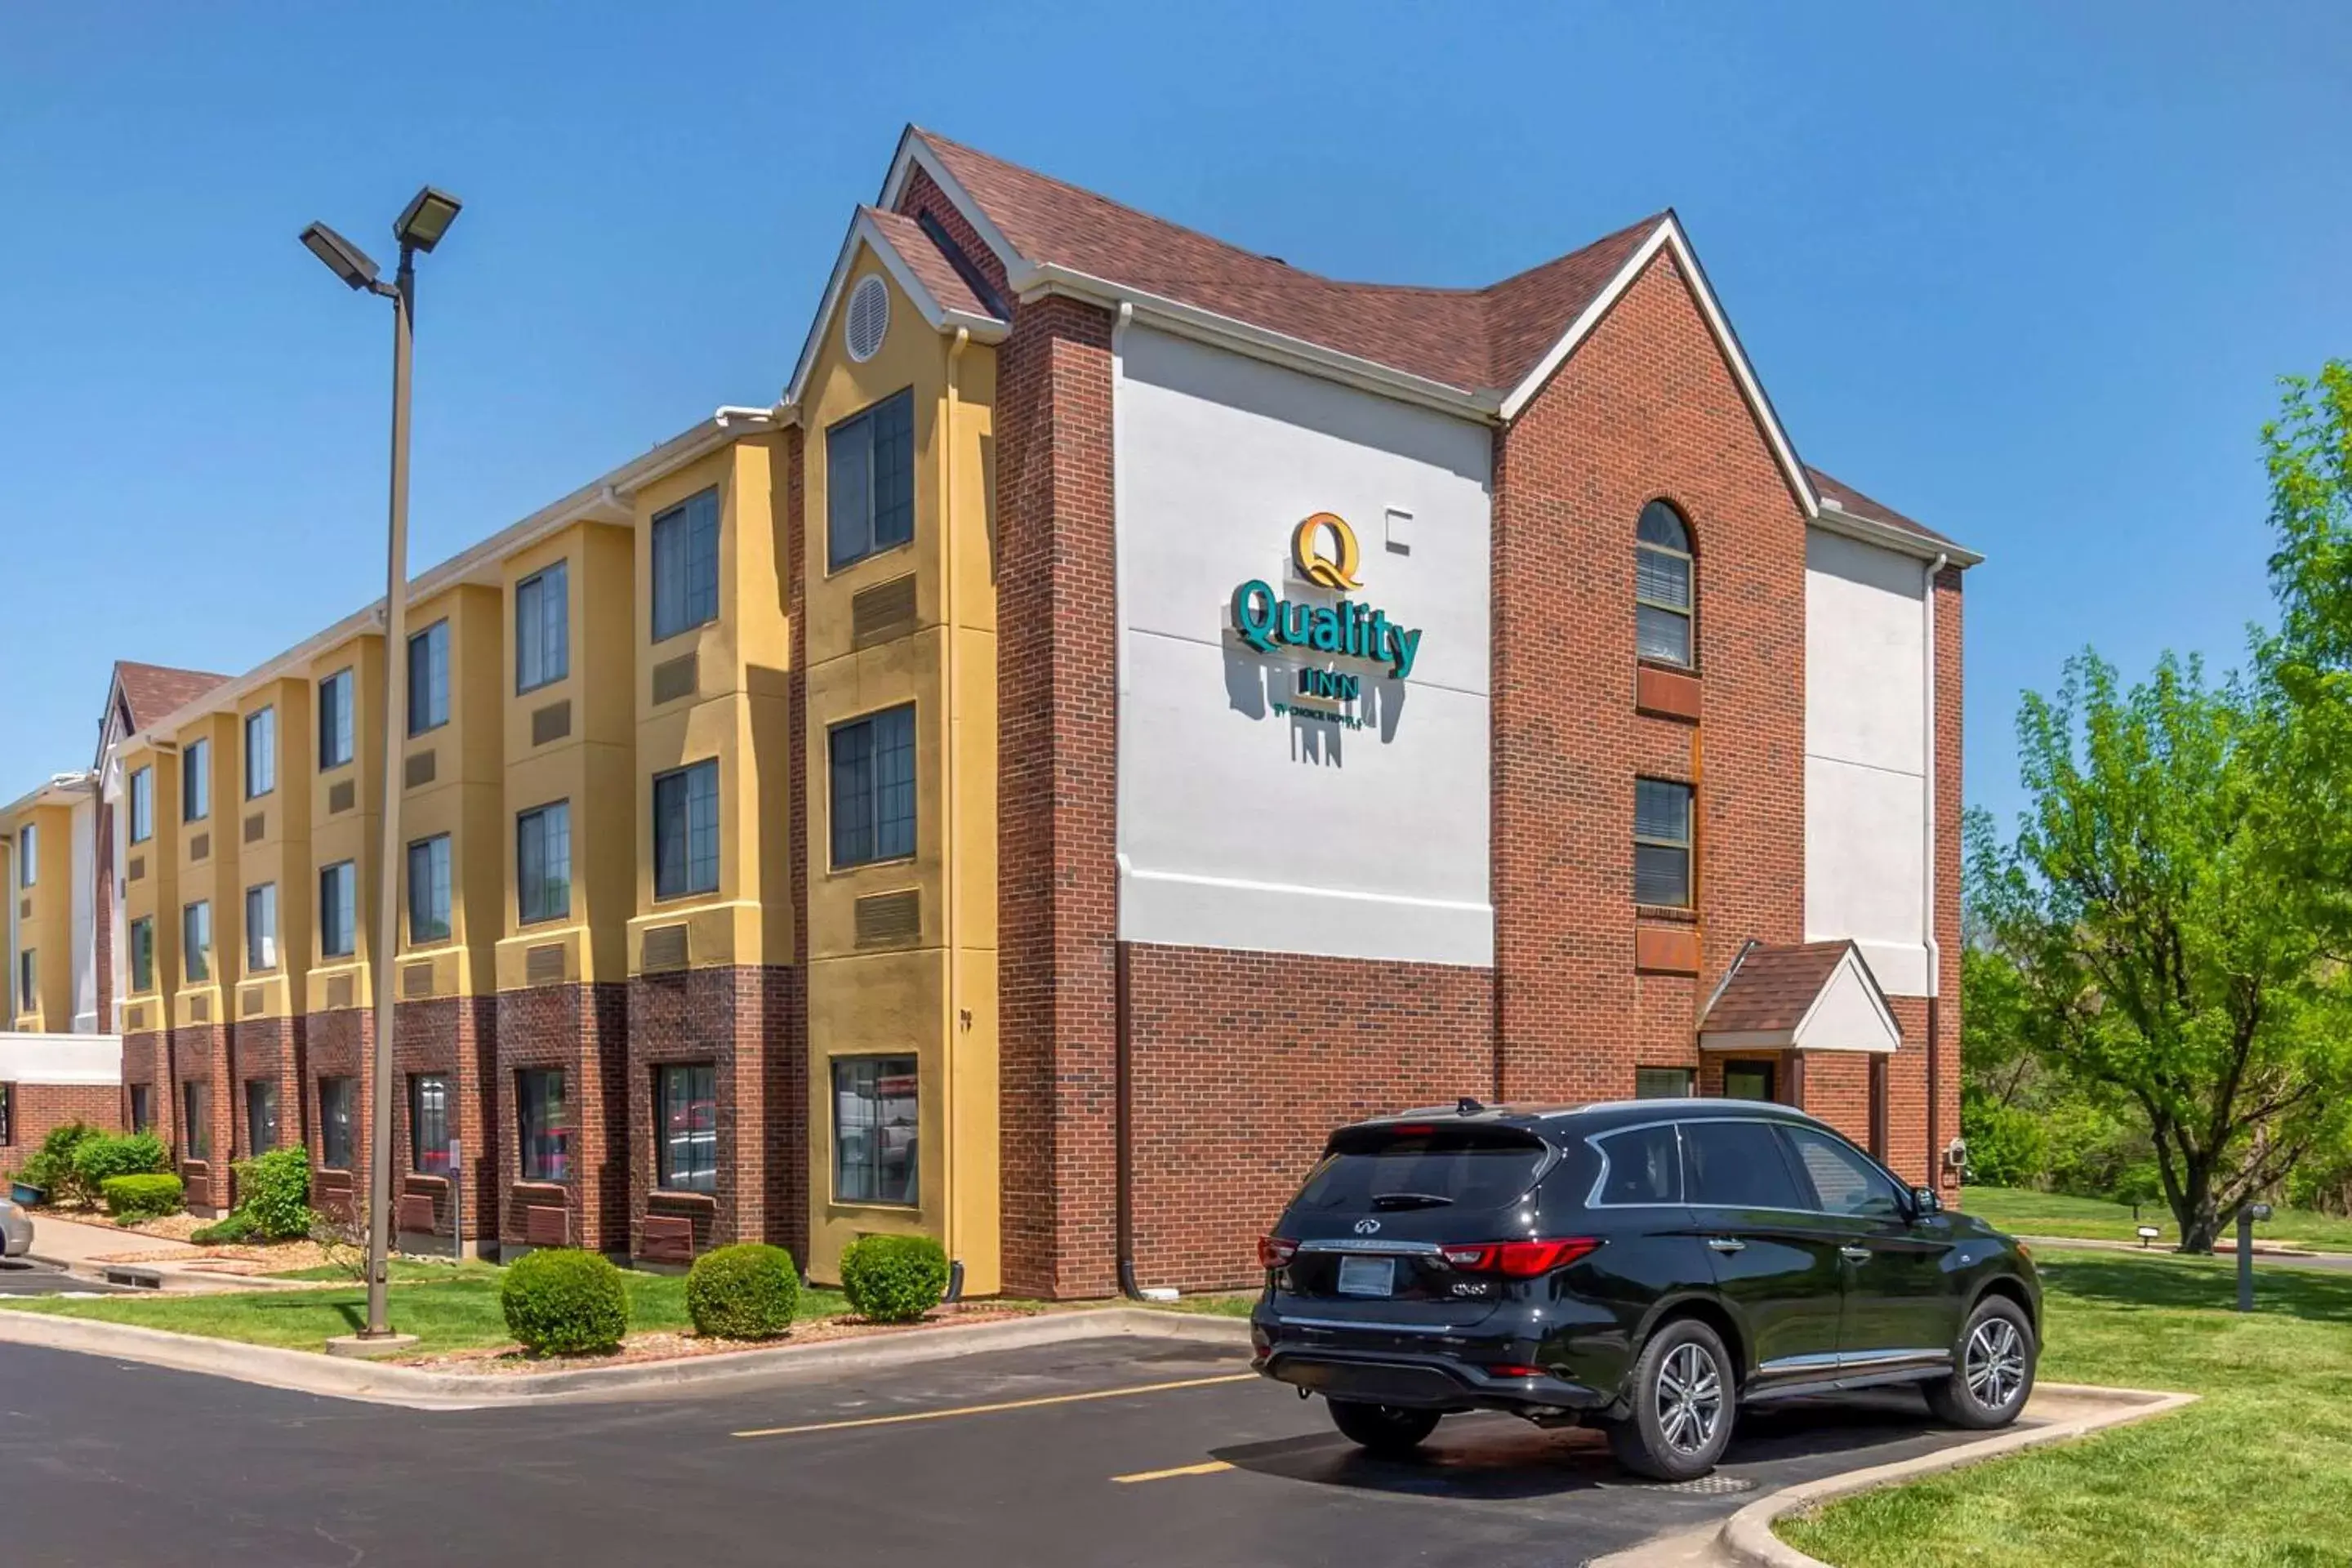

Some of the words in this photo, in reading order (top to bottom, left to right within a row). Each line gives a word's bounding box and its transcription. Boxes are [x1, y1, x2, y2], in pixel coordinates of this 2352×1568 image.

[1291, 512, 1363, 590] Q
[1231, 579, 1422, 678] Quality
[1299, 667, 1358, 700] INN
